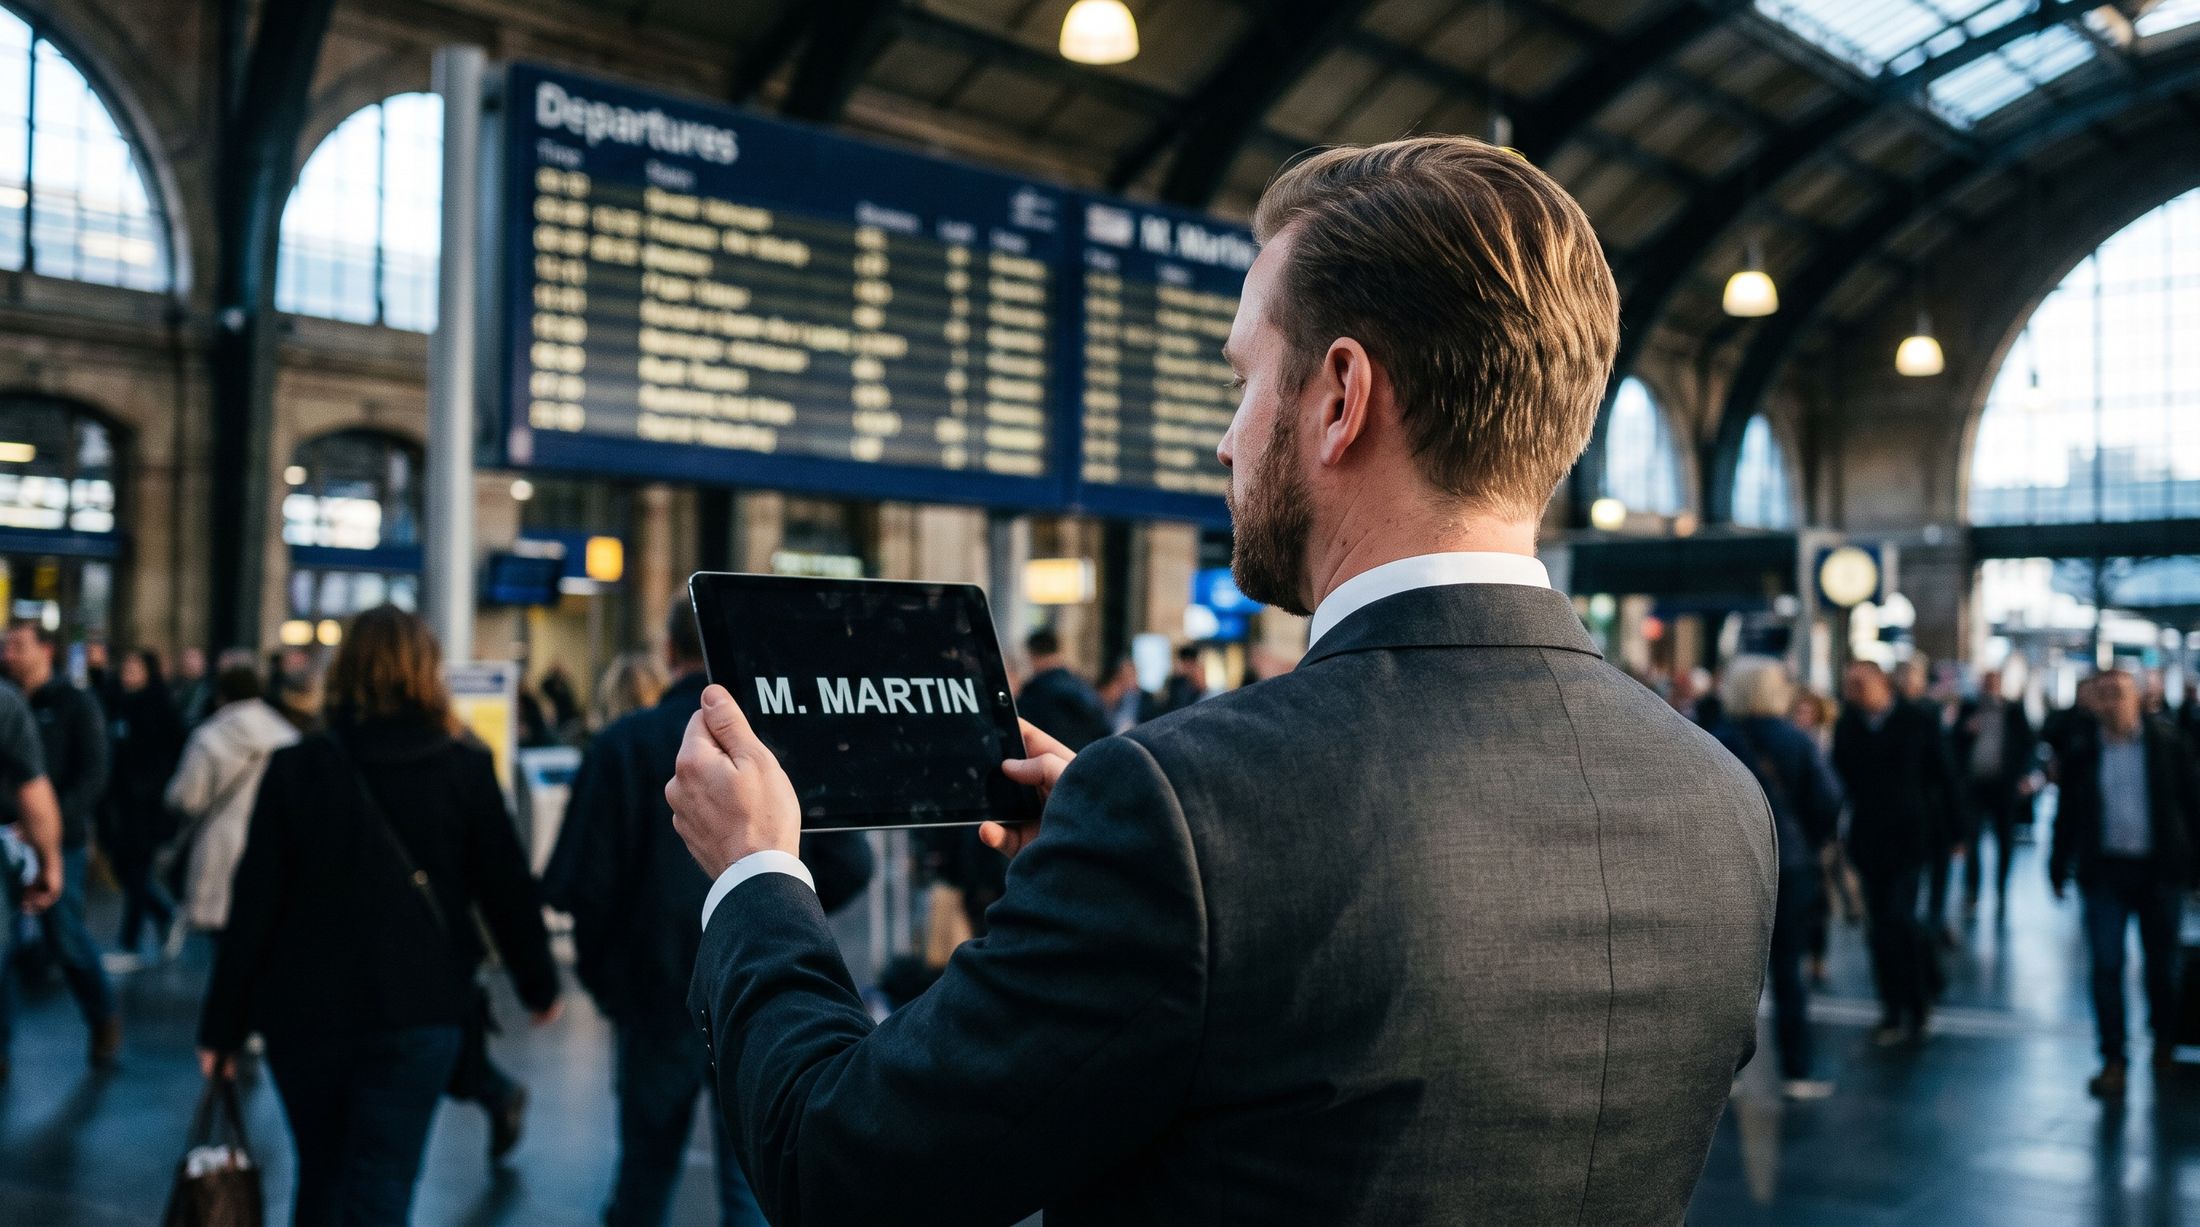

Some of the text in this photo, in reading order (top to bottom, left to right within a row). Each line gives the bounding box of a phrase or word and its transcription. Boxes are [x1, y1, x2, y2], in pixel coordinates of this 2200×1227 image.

[536, 82, 738, 164] Departures
[755, 677, 980, 714] M. MARTIN
